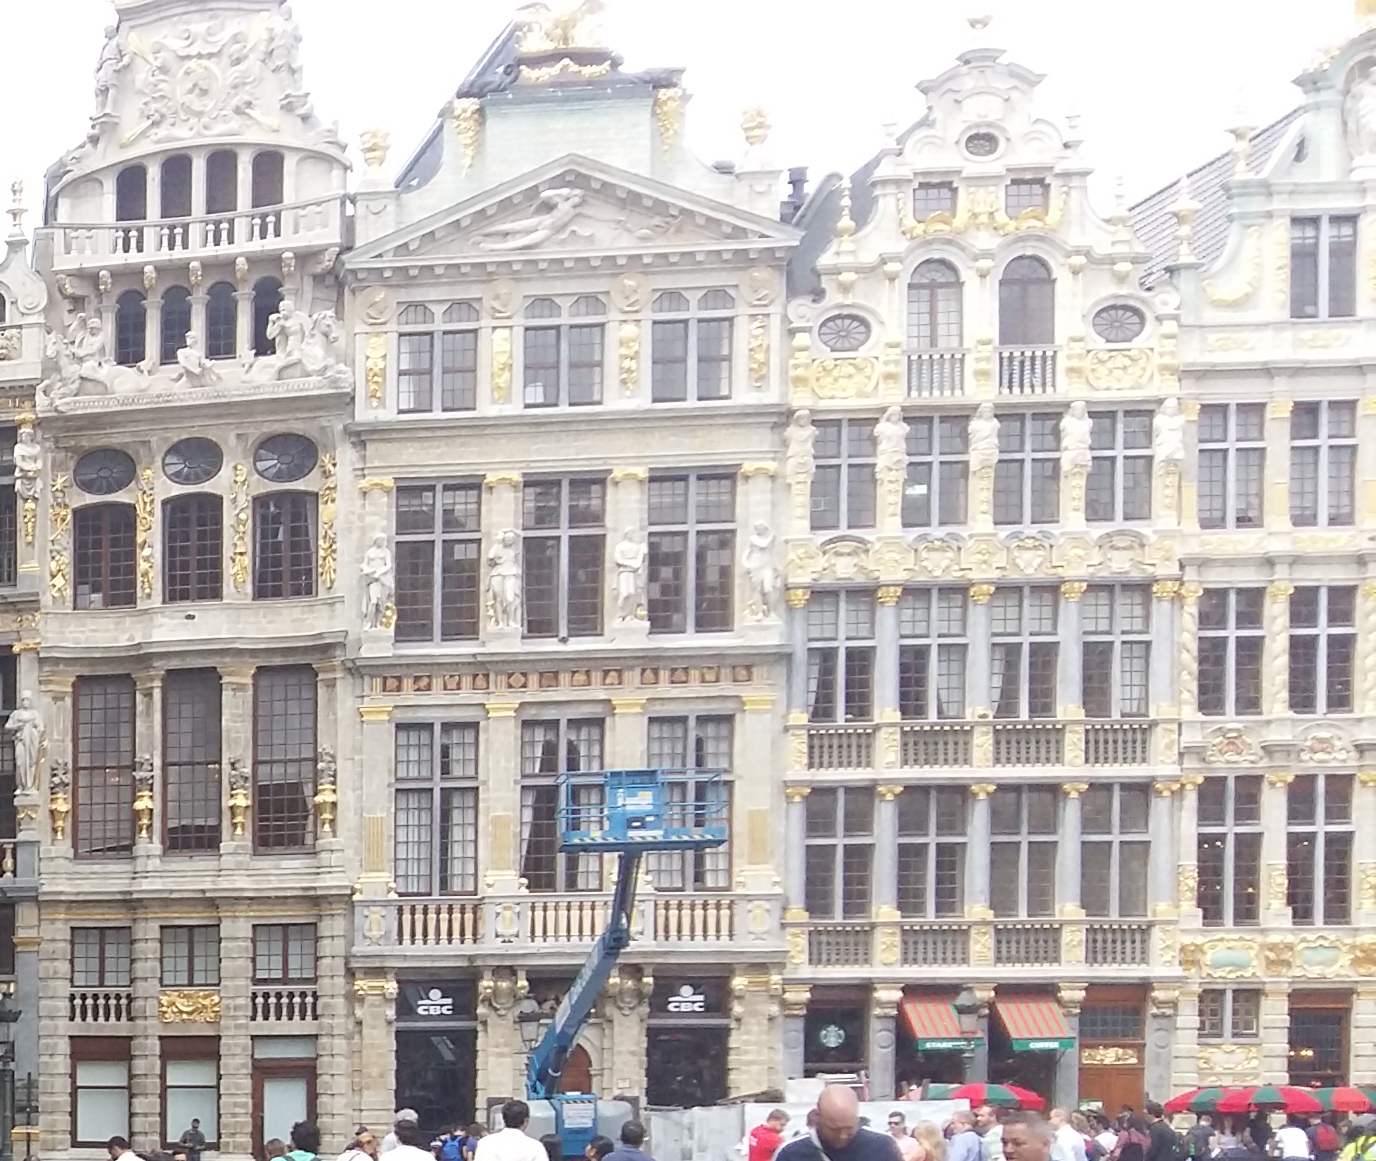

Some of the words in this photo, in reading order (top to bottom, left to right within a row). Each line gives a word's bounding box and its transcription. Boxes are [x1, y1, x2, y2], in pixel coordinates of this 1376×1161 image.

[417, 1005, 453, 1015] CBC
[668, 1002, 705, 1012] CBC
[926, 1041, 975, 1049] STARBS
